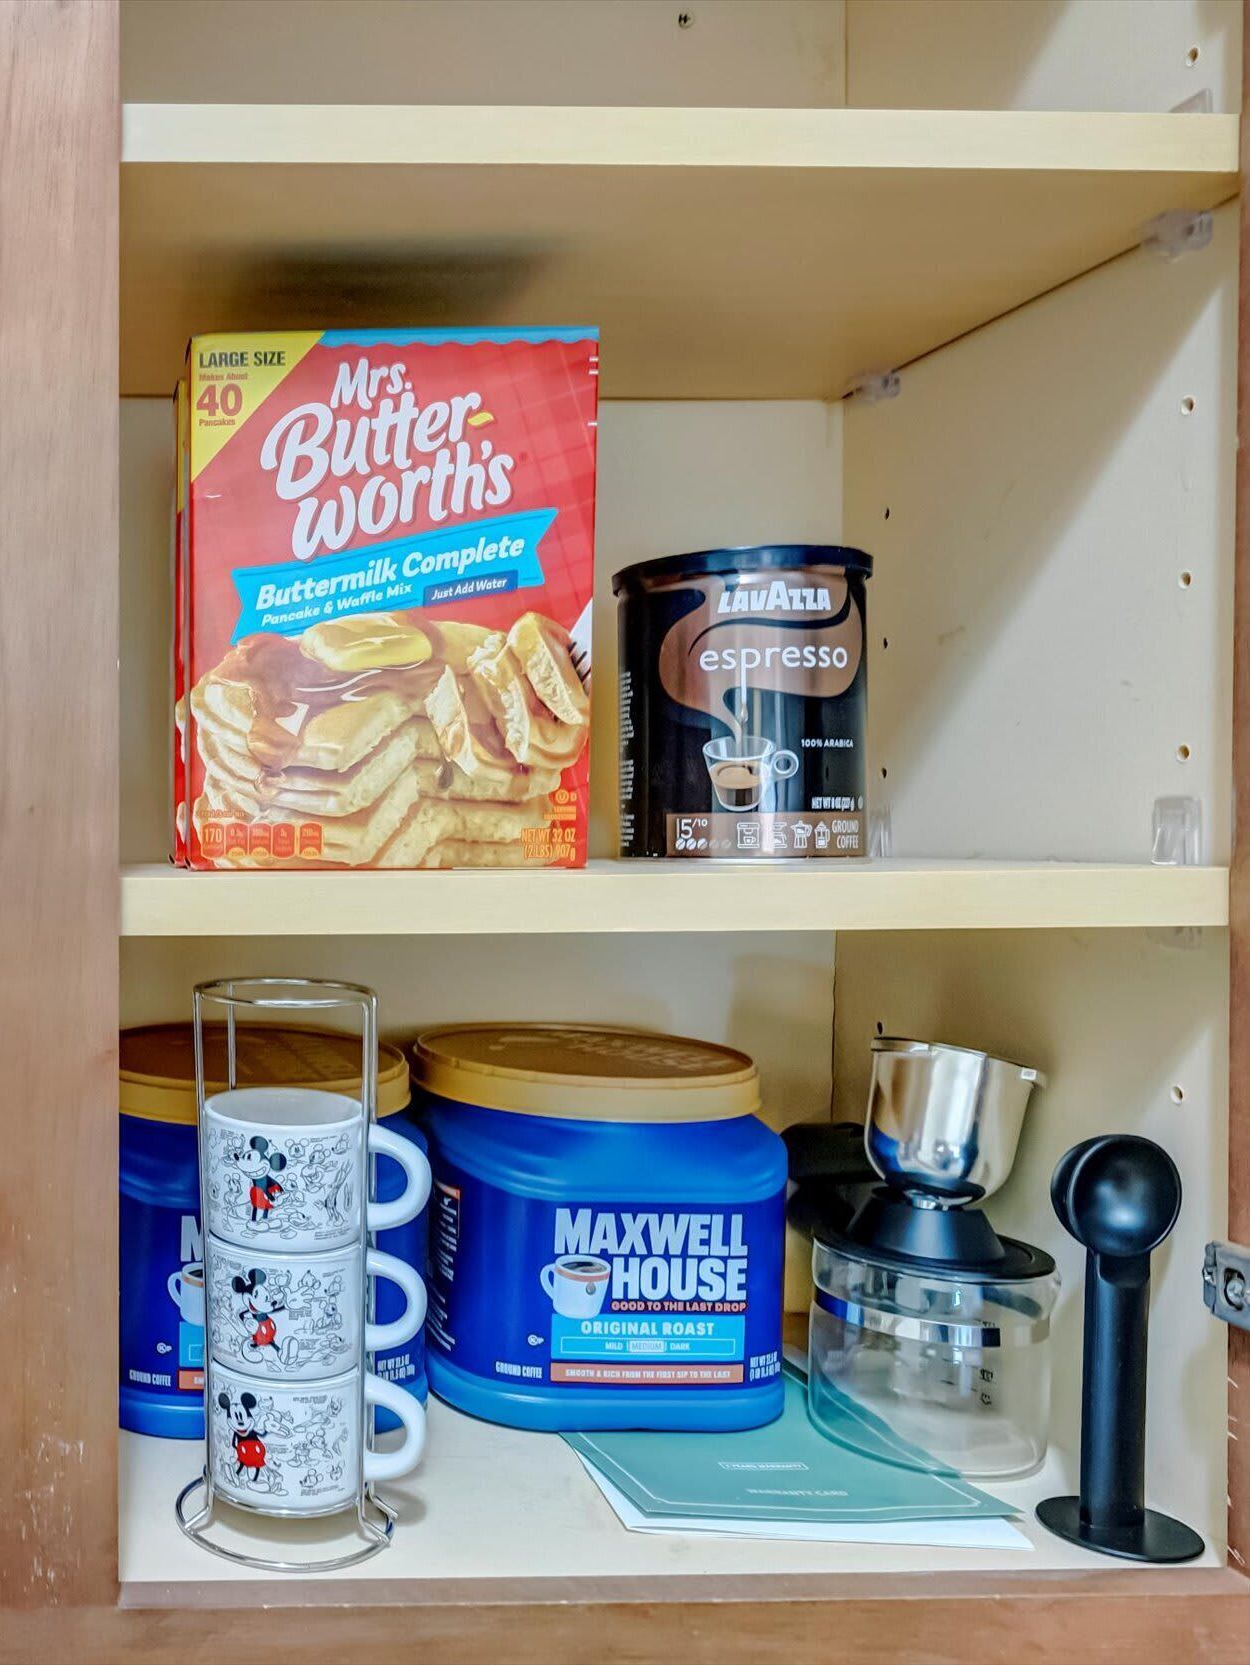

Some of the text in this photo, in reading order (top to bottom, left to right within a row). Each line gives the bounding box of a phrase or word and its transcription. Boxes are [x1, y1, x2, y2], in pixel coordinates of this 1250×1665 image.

[199, 350, 287, 369] LARGE SIZE
[330, 358, 412, 410] Mrs.
[196, 383, 243, 417] 40
[199, 418, 236, 427] Pancakes
[256, 536, 525, 610] Buttermilk Complete
[432, 577, 508, 601] Just Add Water
[718, 580, 831, 614] LAVAZZA
[261, 582, 412, 627] Pancake & Waffle Mix
[700, 645, 848, 686] espresso
[801, 738, 854, 748] 100% ARABICA
[832, 820, 859, 833] GROUND
[204, 828, 222, 843] 170
[521, 828, 576, 843] NET WT 32 OZ
[837, 834, 859, 849] COFFEE
[554, 1207, 748, 1257] MAXWELL
[611, 1256, 748, 1301] HOUSE
[611, 1301, 747, 1313] GOOD TO THE LAST DROP
[581, 1321, 715, 1337] ORIGINAL ROAST
[605, 1341, 691, 1351] MILD MEDIUM DARK
[495, 1360, 543, 1379] GROUND COFFEE
[565, 1369, 594, 1378] SMOOTH
[603, 1370, 620, 1378] RICH
[622, 1370, 641, 1379] FROM
[643, 1370, 655, 1379] THE
[656, 1370, 675, 1379] FIRST
[676, 1370, 687, 1379] SIP
[688, 1370, 698, 1379] TO
[700, 1370, 712, 1379] THE
[713, 1370, 731, 1378] LAST
[152, 1373, 171, 1387] COFFEE
